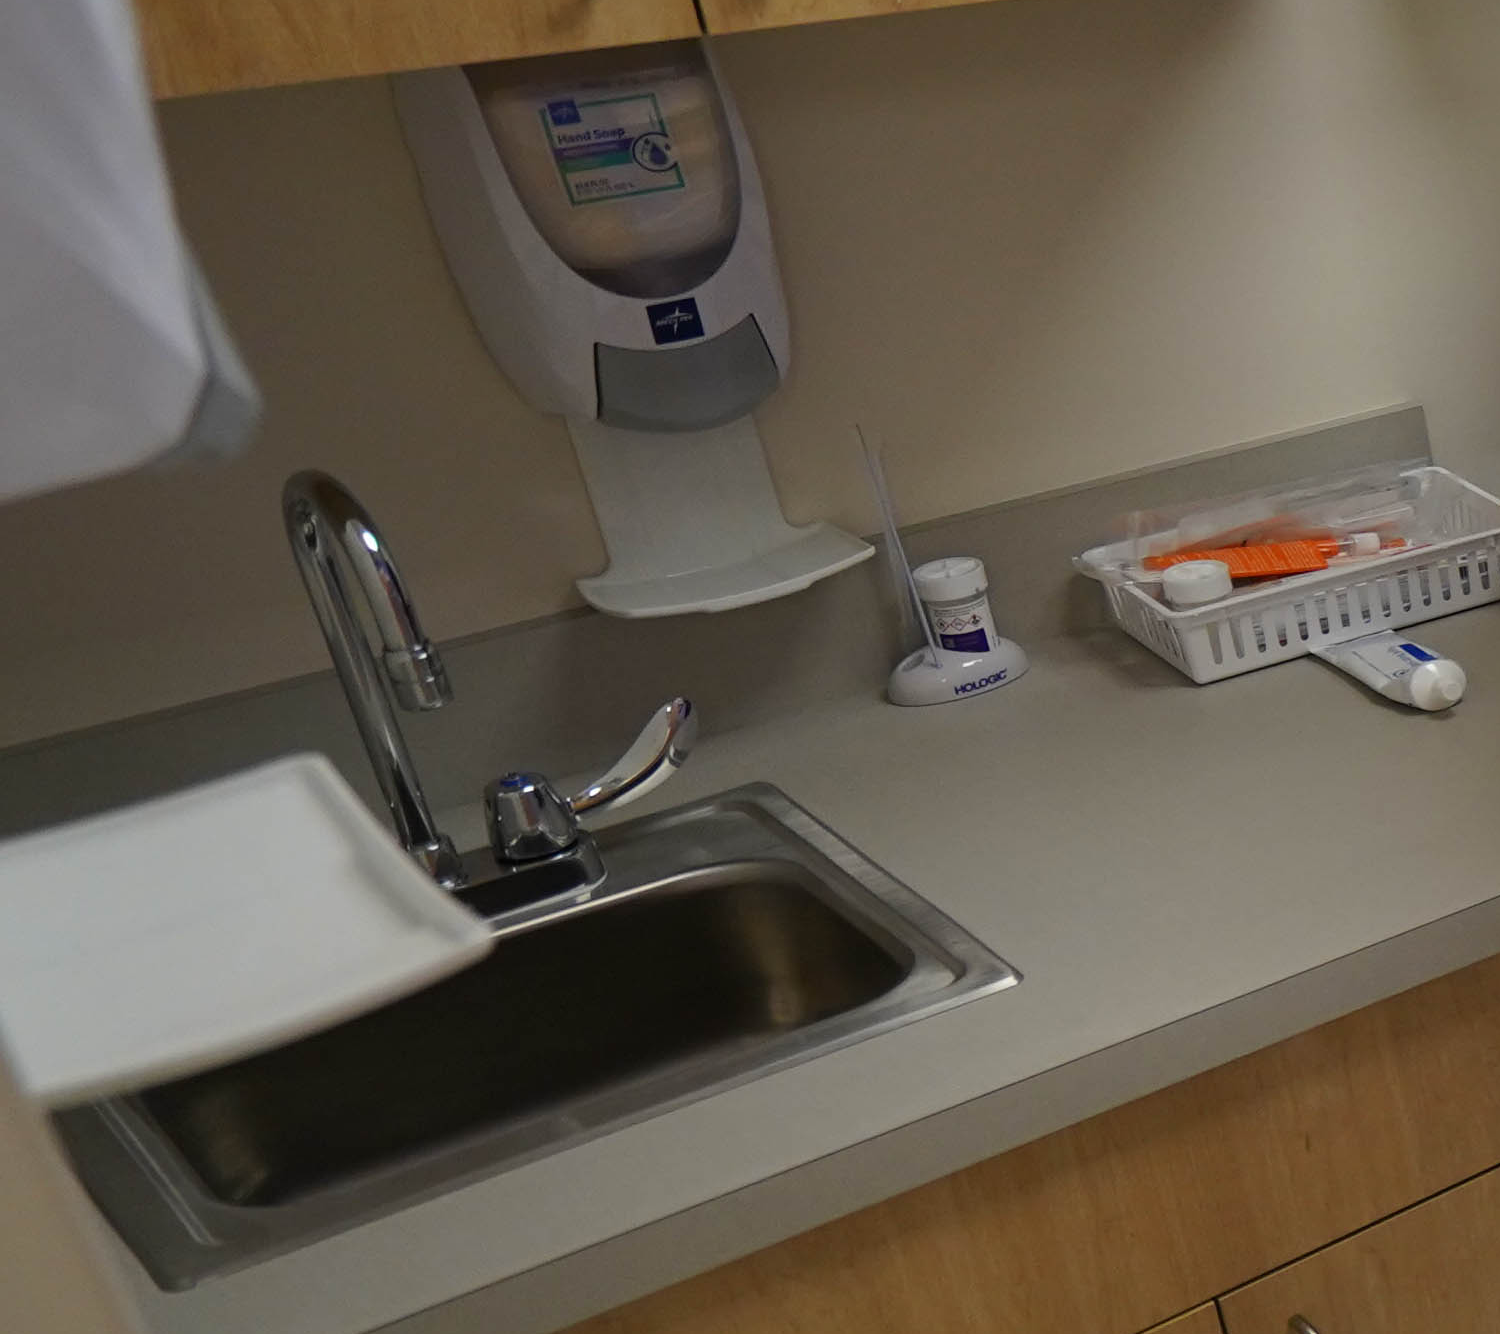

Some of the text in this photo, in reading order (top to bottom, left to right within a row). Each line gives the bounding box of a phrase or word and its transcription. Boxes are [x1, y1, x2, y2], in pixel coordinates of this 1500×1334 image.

[557, 127, 626, 145] Hand Soap
[953, 668, 1008, 695] HOLOGIC
